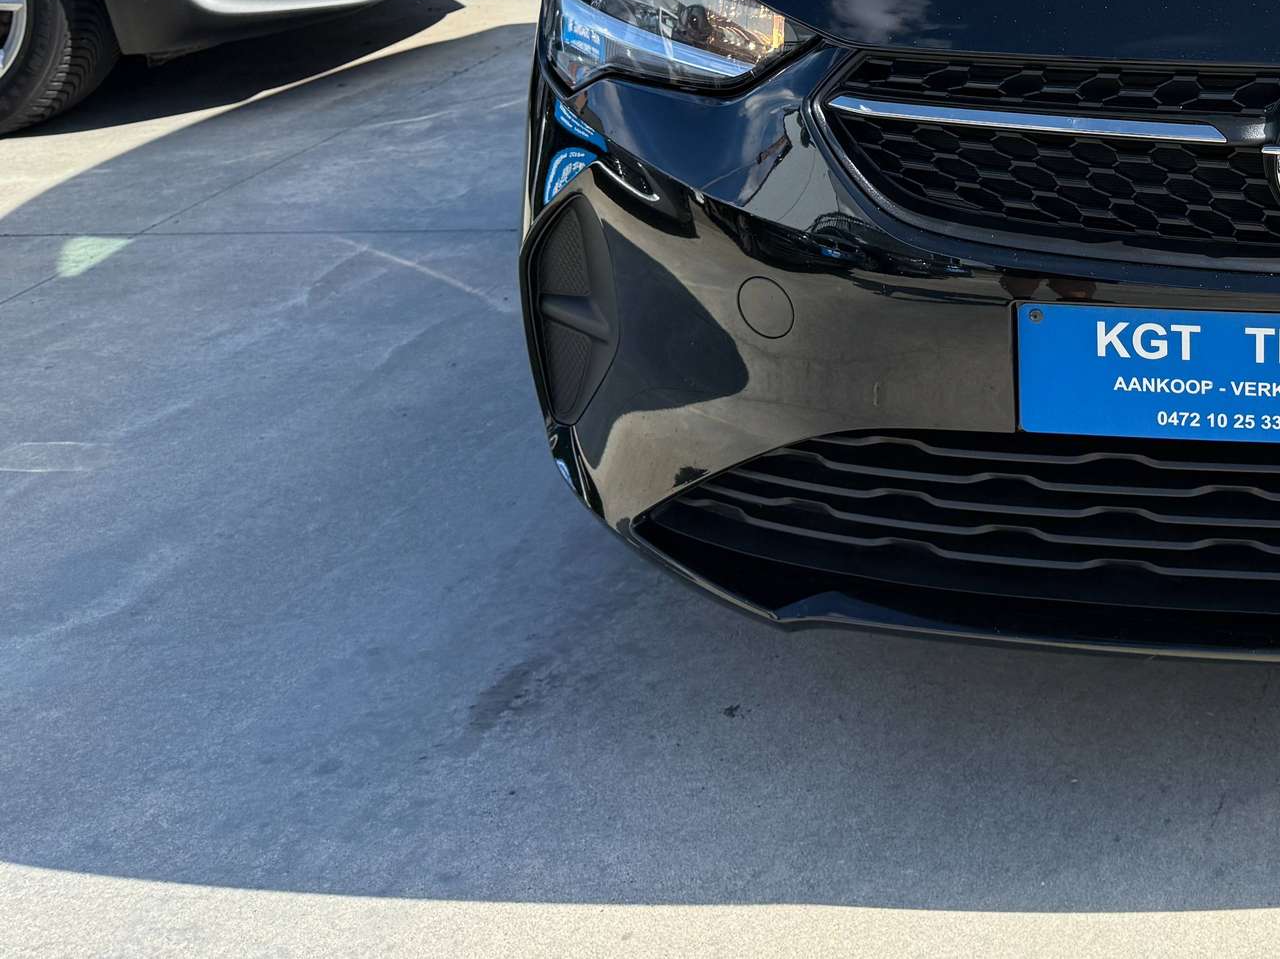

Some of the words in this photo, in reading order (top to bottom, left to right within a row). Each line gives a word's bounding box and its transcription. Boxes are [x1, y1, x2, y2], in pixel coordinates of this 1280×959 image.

[1096, 321, 1201, 361] KGT
[1113, 376, 1213, 395] AANKOOP
[1157, 411, 1201, 427] 0472
[1206, 413, 1228, 428] 10
[1233, 414, 1256, 429] 25
